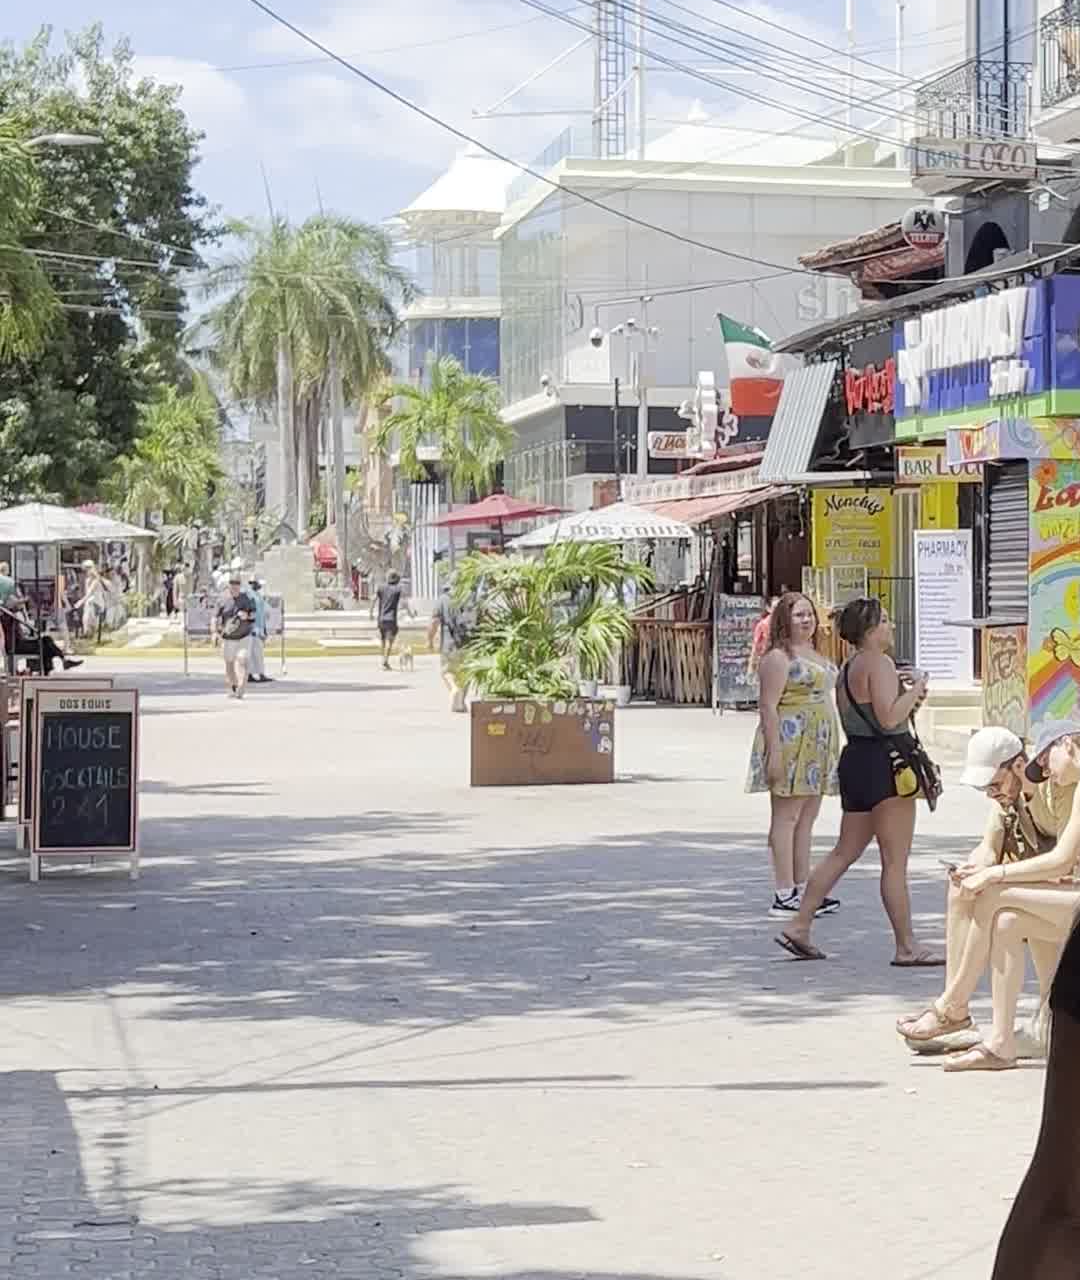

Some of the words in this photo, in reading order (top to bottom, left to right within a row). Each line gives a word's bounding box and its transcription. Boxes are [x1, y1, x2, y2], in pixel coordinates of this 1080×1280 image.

[963, 142, 1026, 173] LOCO
[903, 460, 932, 476] BAR
[917, 540, 968, 559] PHARMACY
[48, 724, 121, 750] HOUSE
